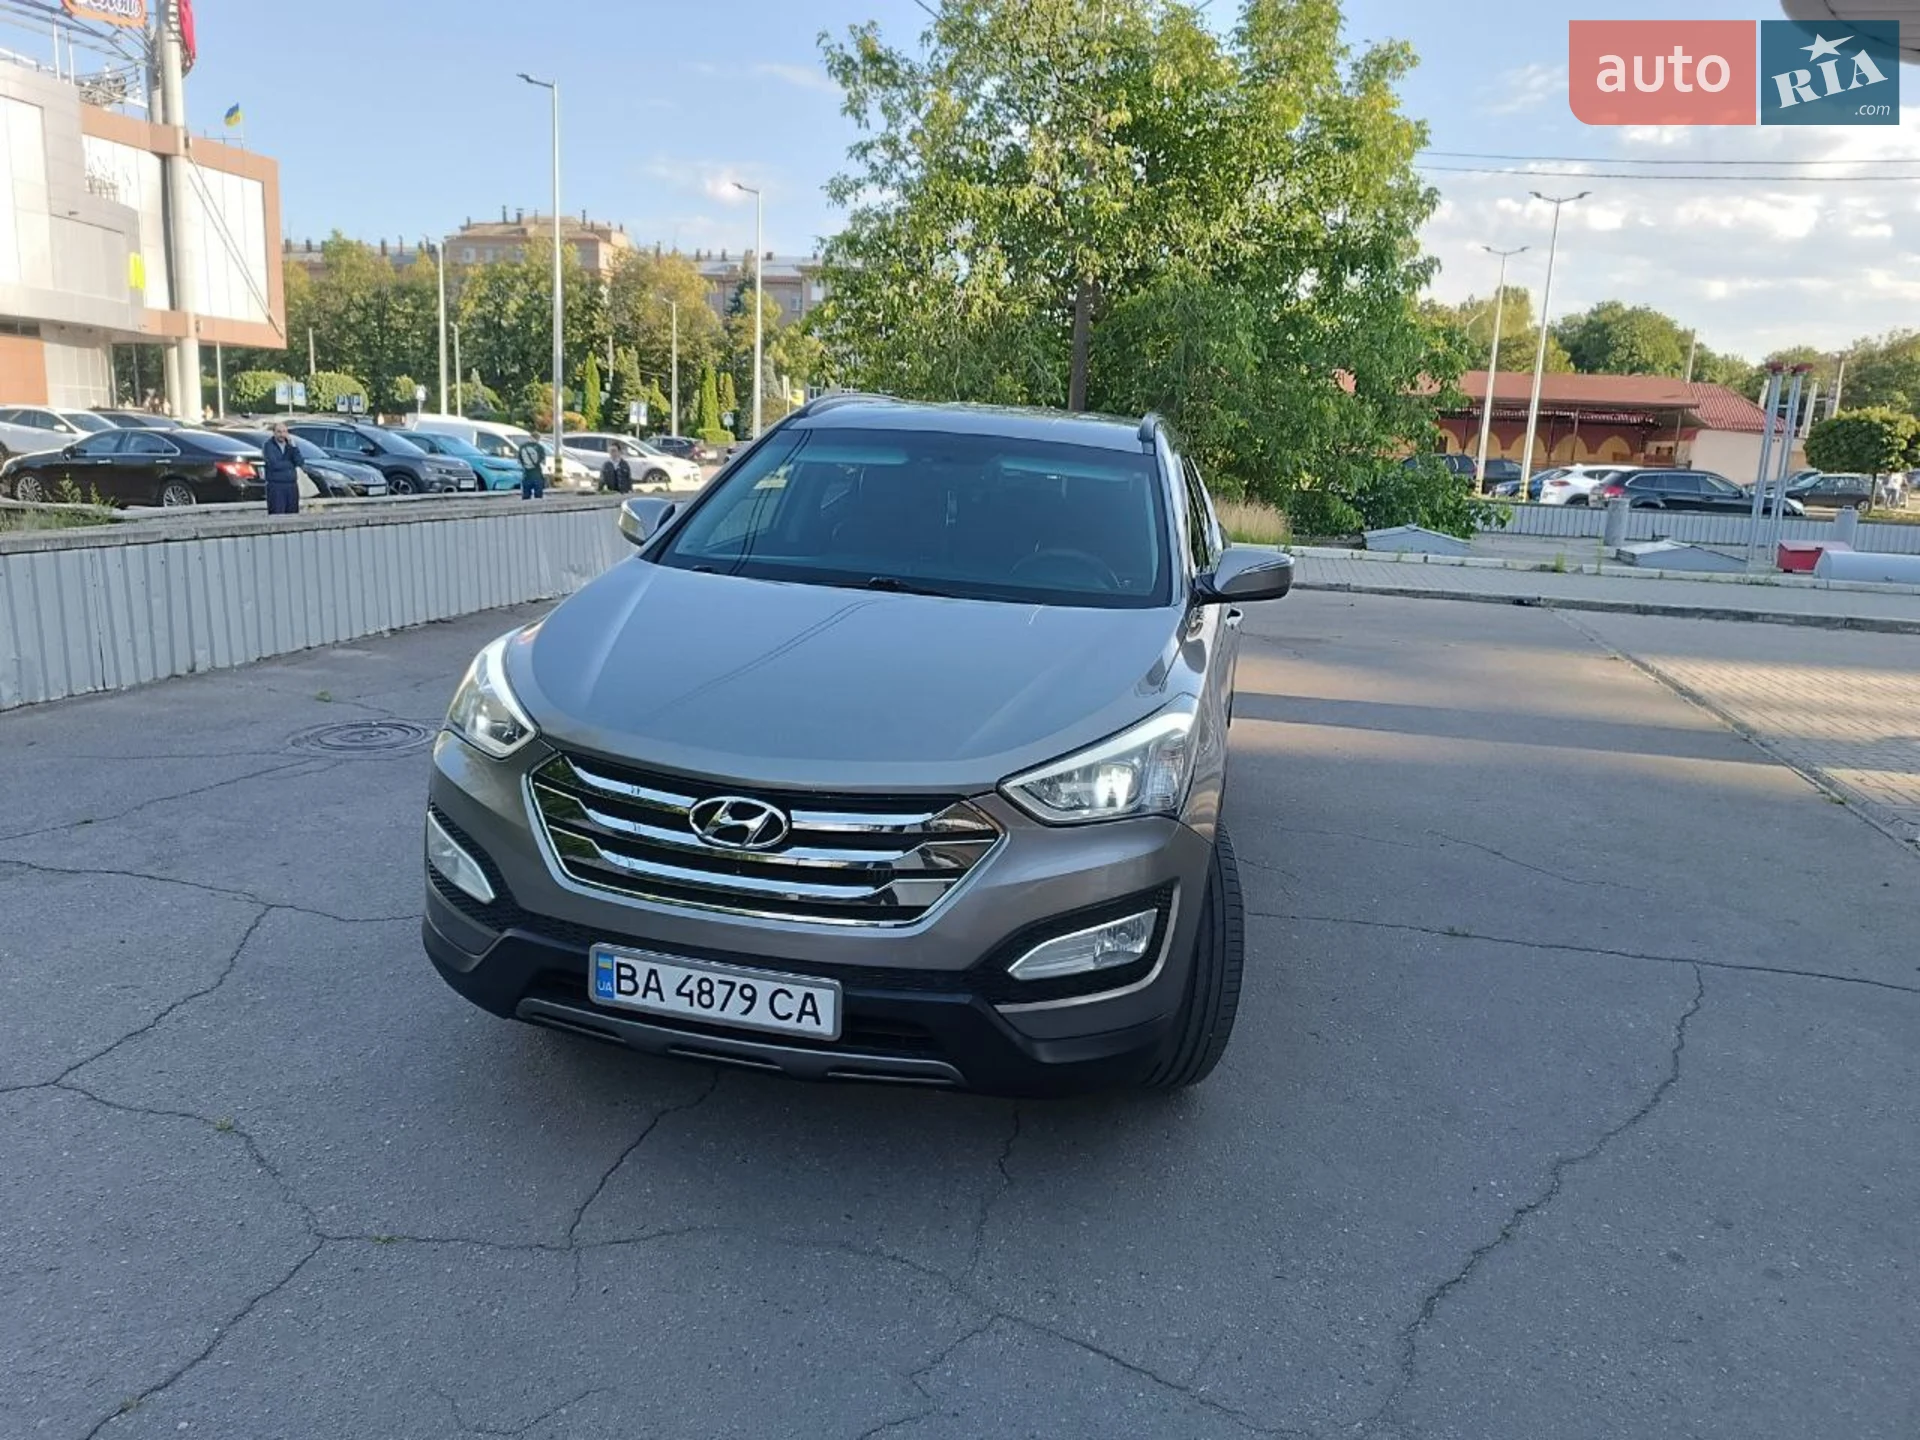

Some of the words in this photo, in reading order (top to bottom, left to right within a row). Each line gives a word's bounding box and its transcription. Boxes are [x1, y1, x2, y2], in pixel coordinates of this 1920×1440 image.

[597, 980, 613, 992] UA
[615, 961, 665, 1003] BA
[675, 974, 758, 1017] 4879
[768, 988, 822, 1026] CA
